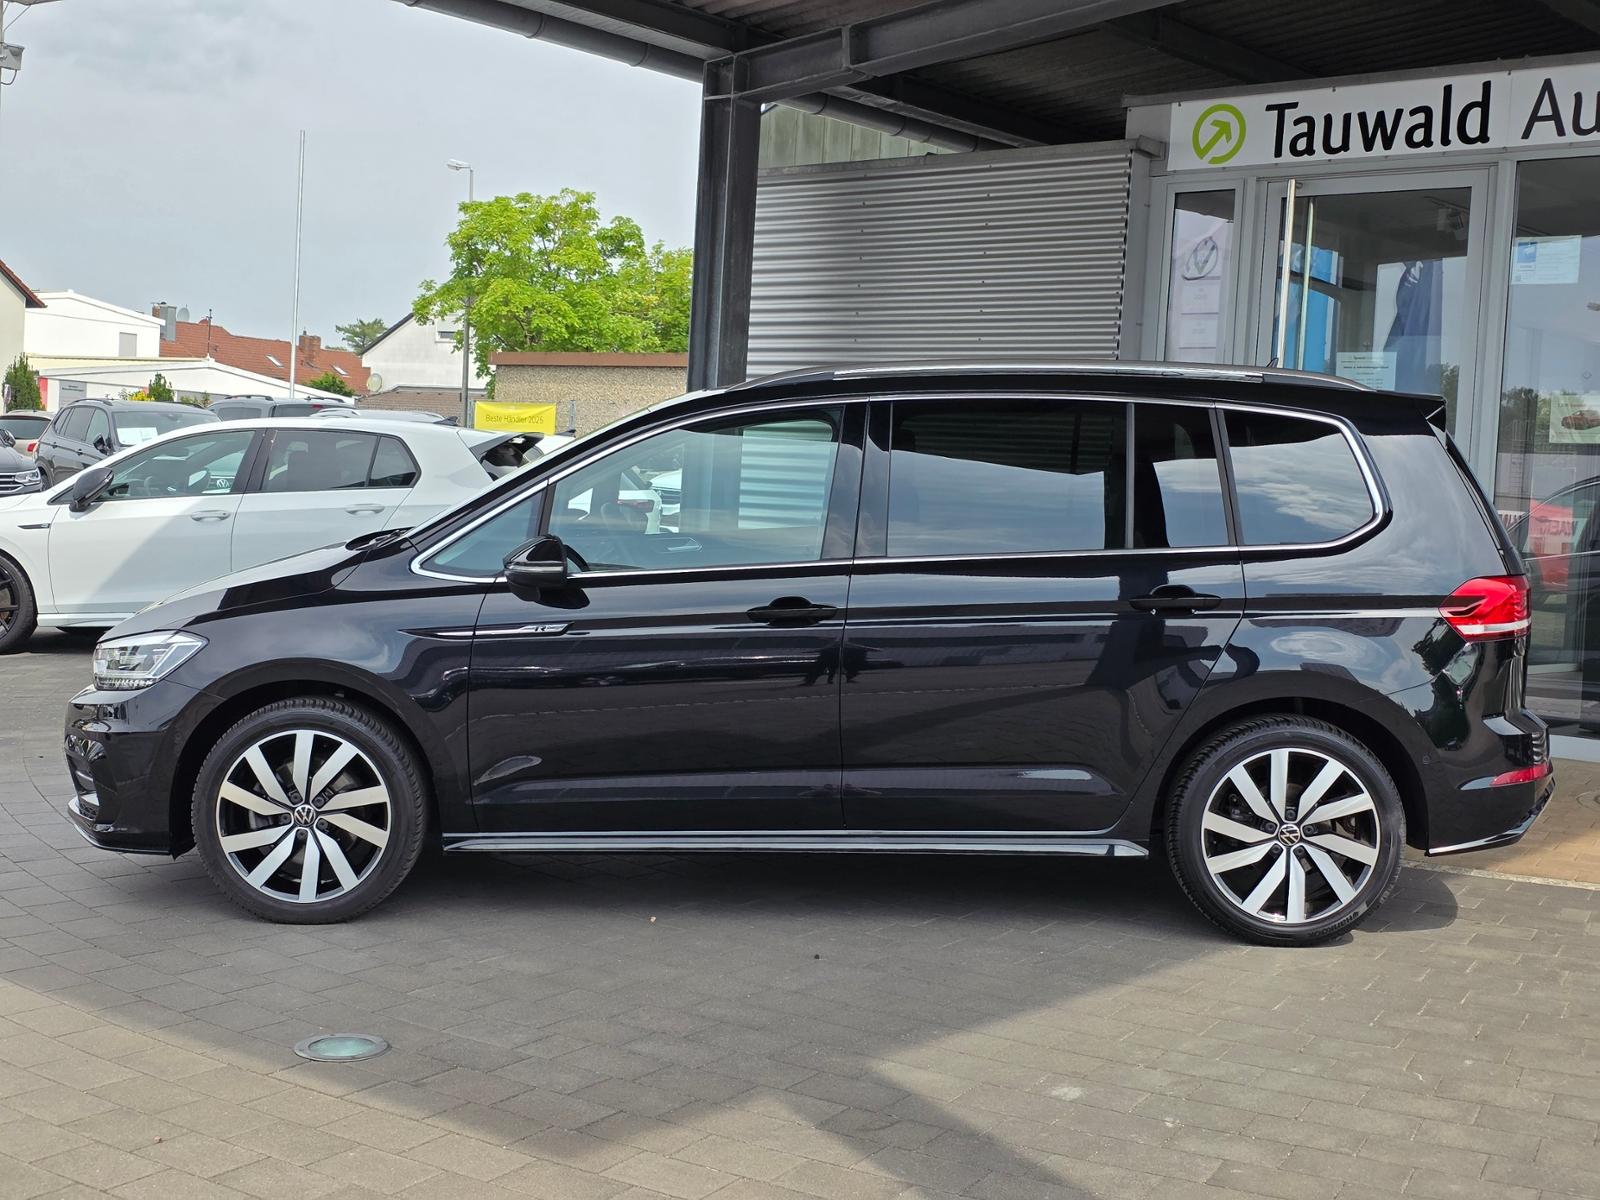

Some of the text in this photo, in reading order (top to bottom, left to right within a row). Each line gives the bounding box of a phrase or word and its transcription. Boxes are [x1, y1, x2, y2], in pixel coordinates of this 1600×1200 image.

[1265, 78, 1600, 158] Tauwald Au
[486, 414, 502, 422] Beste
